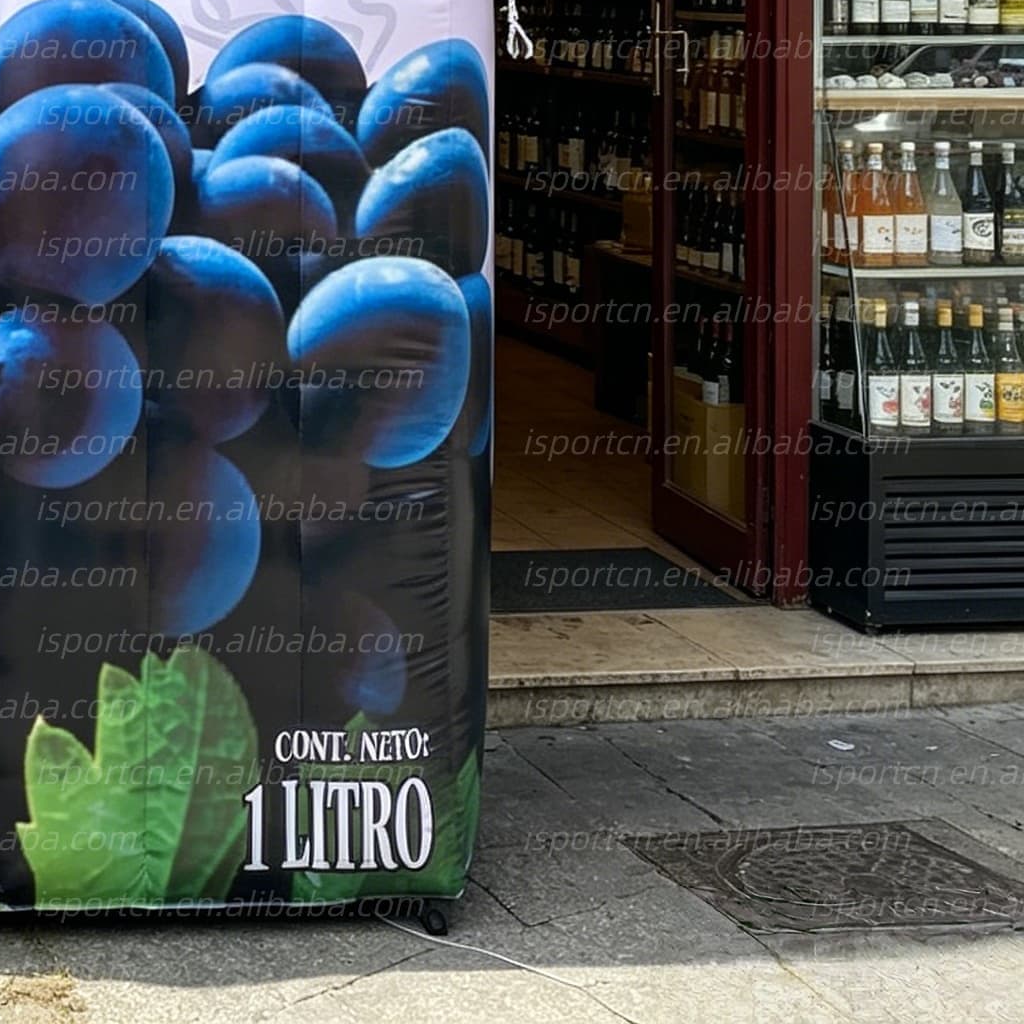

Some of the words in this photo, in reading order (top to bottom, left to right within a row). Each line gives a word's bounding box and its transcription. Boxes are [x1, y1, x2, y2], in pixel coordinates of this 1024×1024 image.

[276, 730, 352, 762] CONT.
[243, 784, 270, 871] 1
[281, 776, 434, 870] LITRO
